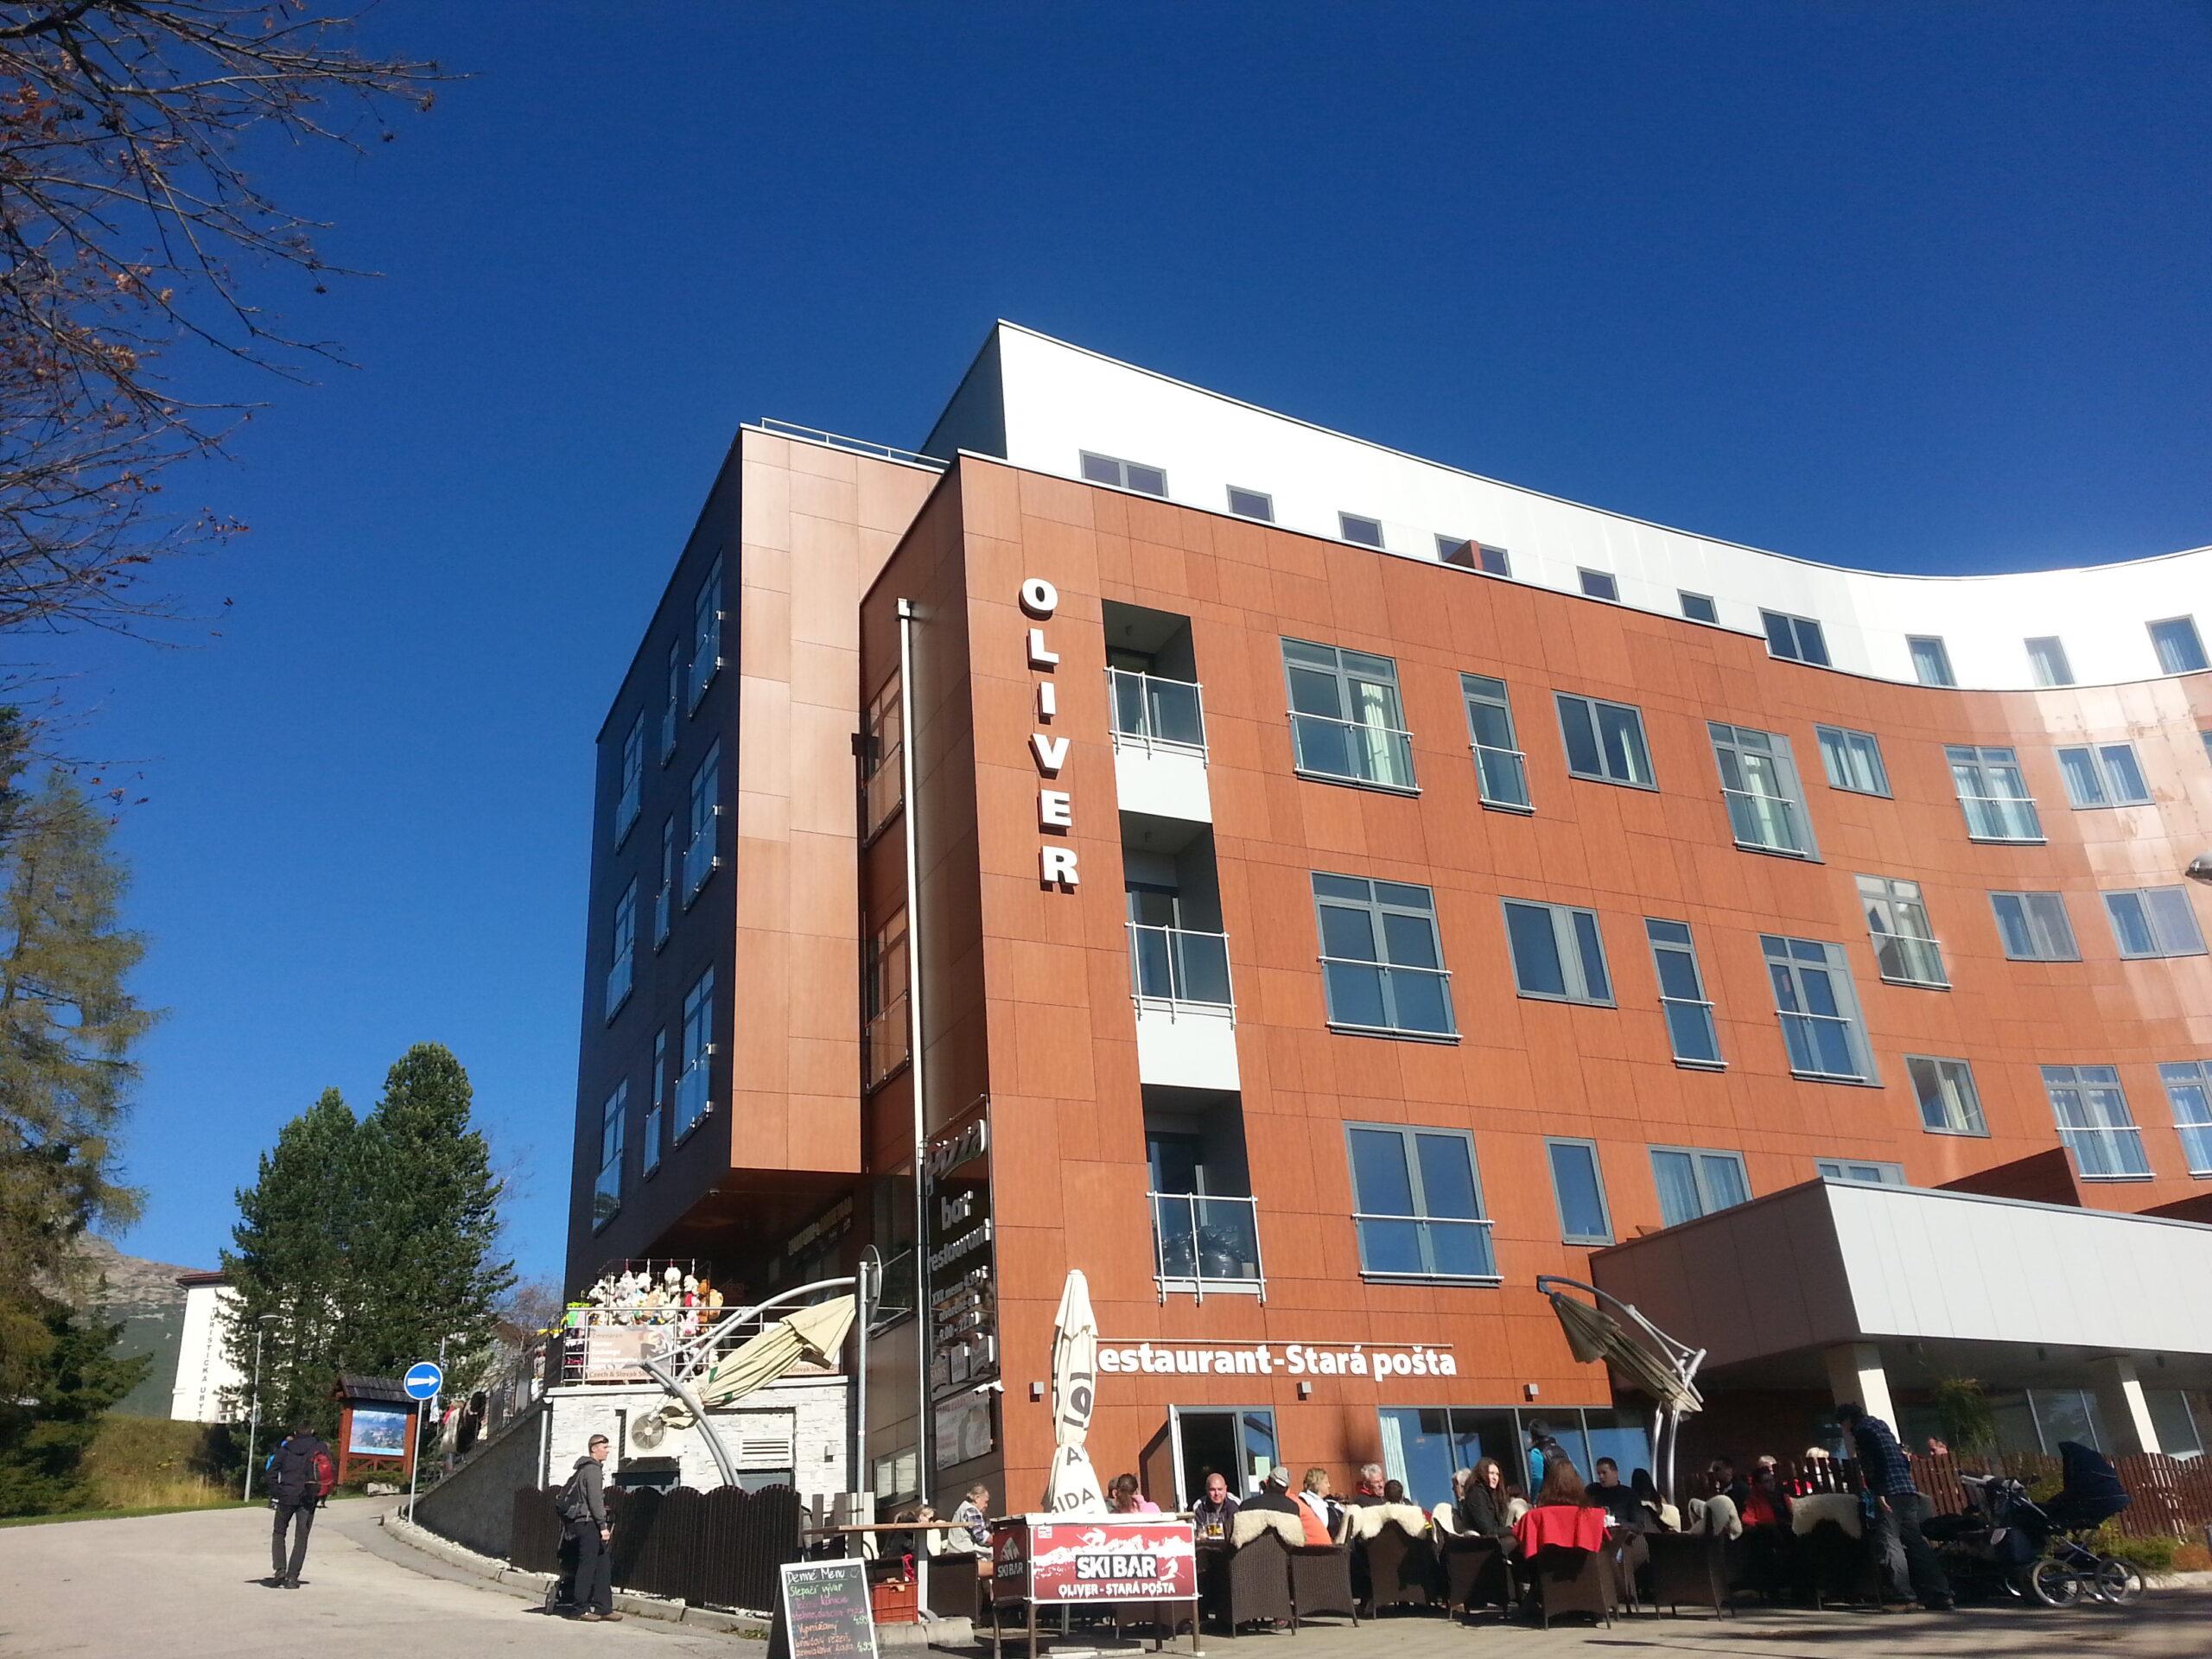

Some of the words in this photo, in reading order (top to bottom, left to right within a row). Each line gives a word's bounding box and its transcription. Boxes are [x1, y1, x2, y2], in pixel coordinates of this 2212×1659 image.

[1021, 577, 1079, 885] OLIVER
[941, 1190, 974, 1230] bar
[927, 1218, 991, 1274] restaurant
[1375, 1345, 1457, 1382] pošta
[785, 1569, 817, 1585] Denné
[820, 1567, 846, 1580] Menu
[1077, 1556, 1111, 1579] SKI
[1113, 1556, 1158, 1579] BAR
[1058, 1584, 1098, 1599] OLIVER
[1106, 1580, 1140, 1597] STARÁ
[1142, 1580, 1176, 1597] POŠTA
